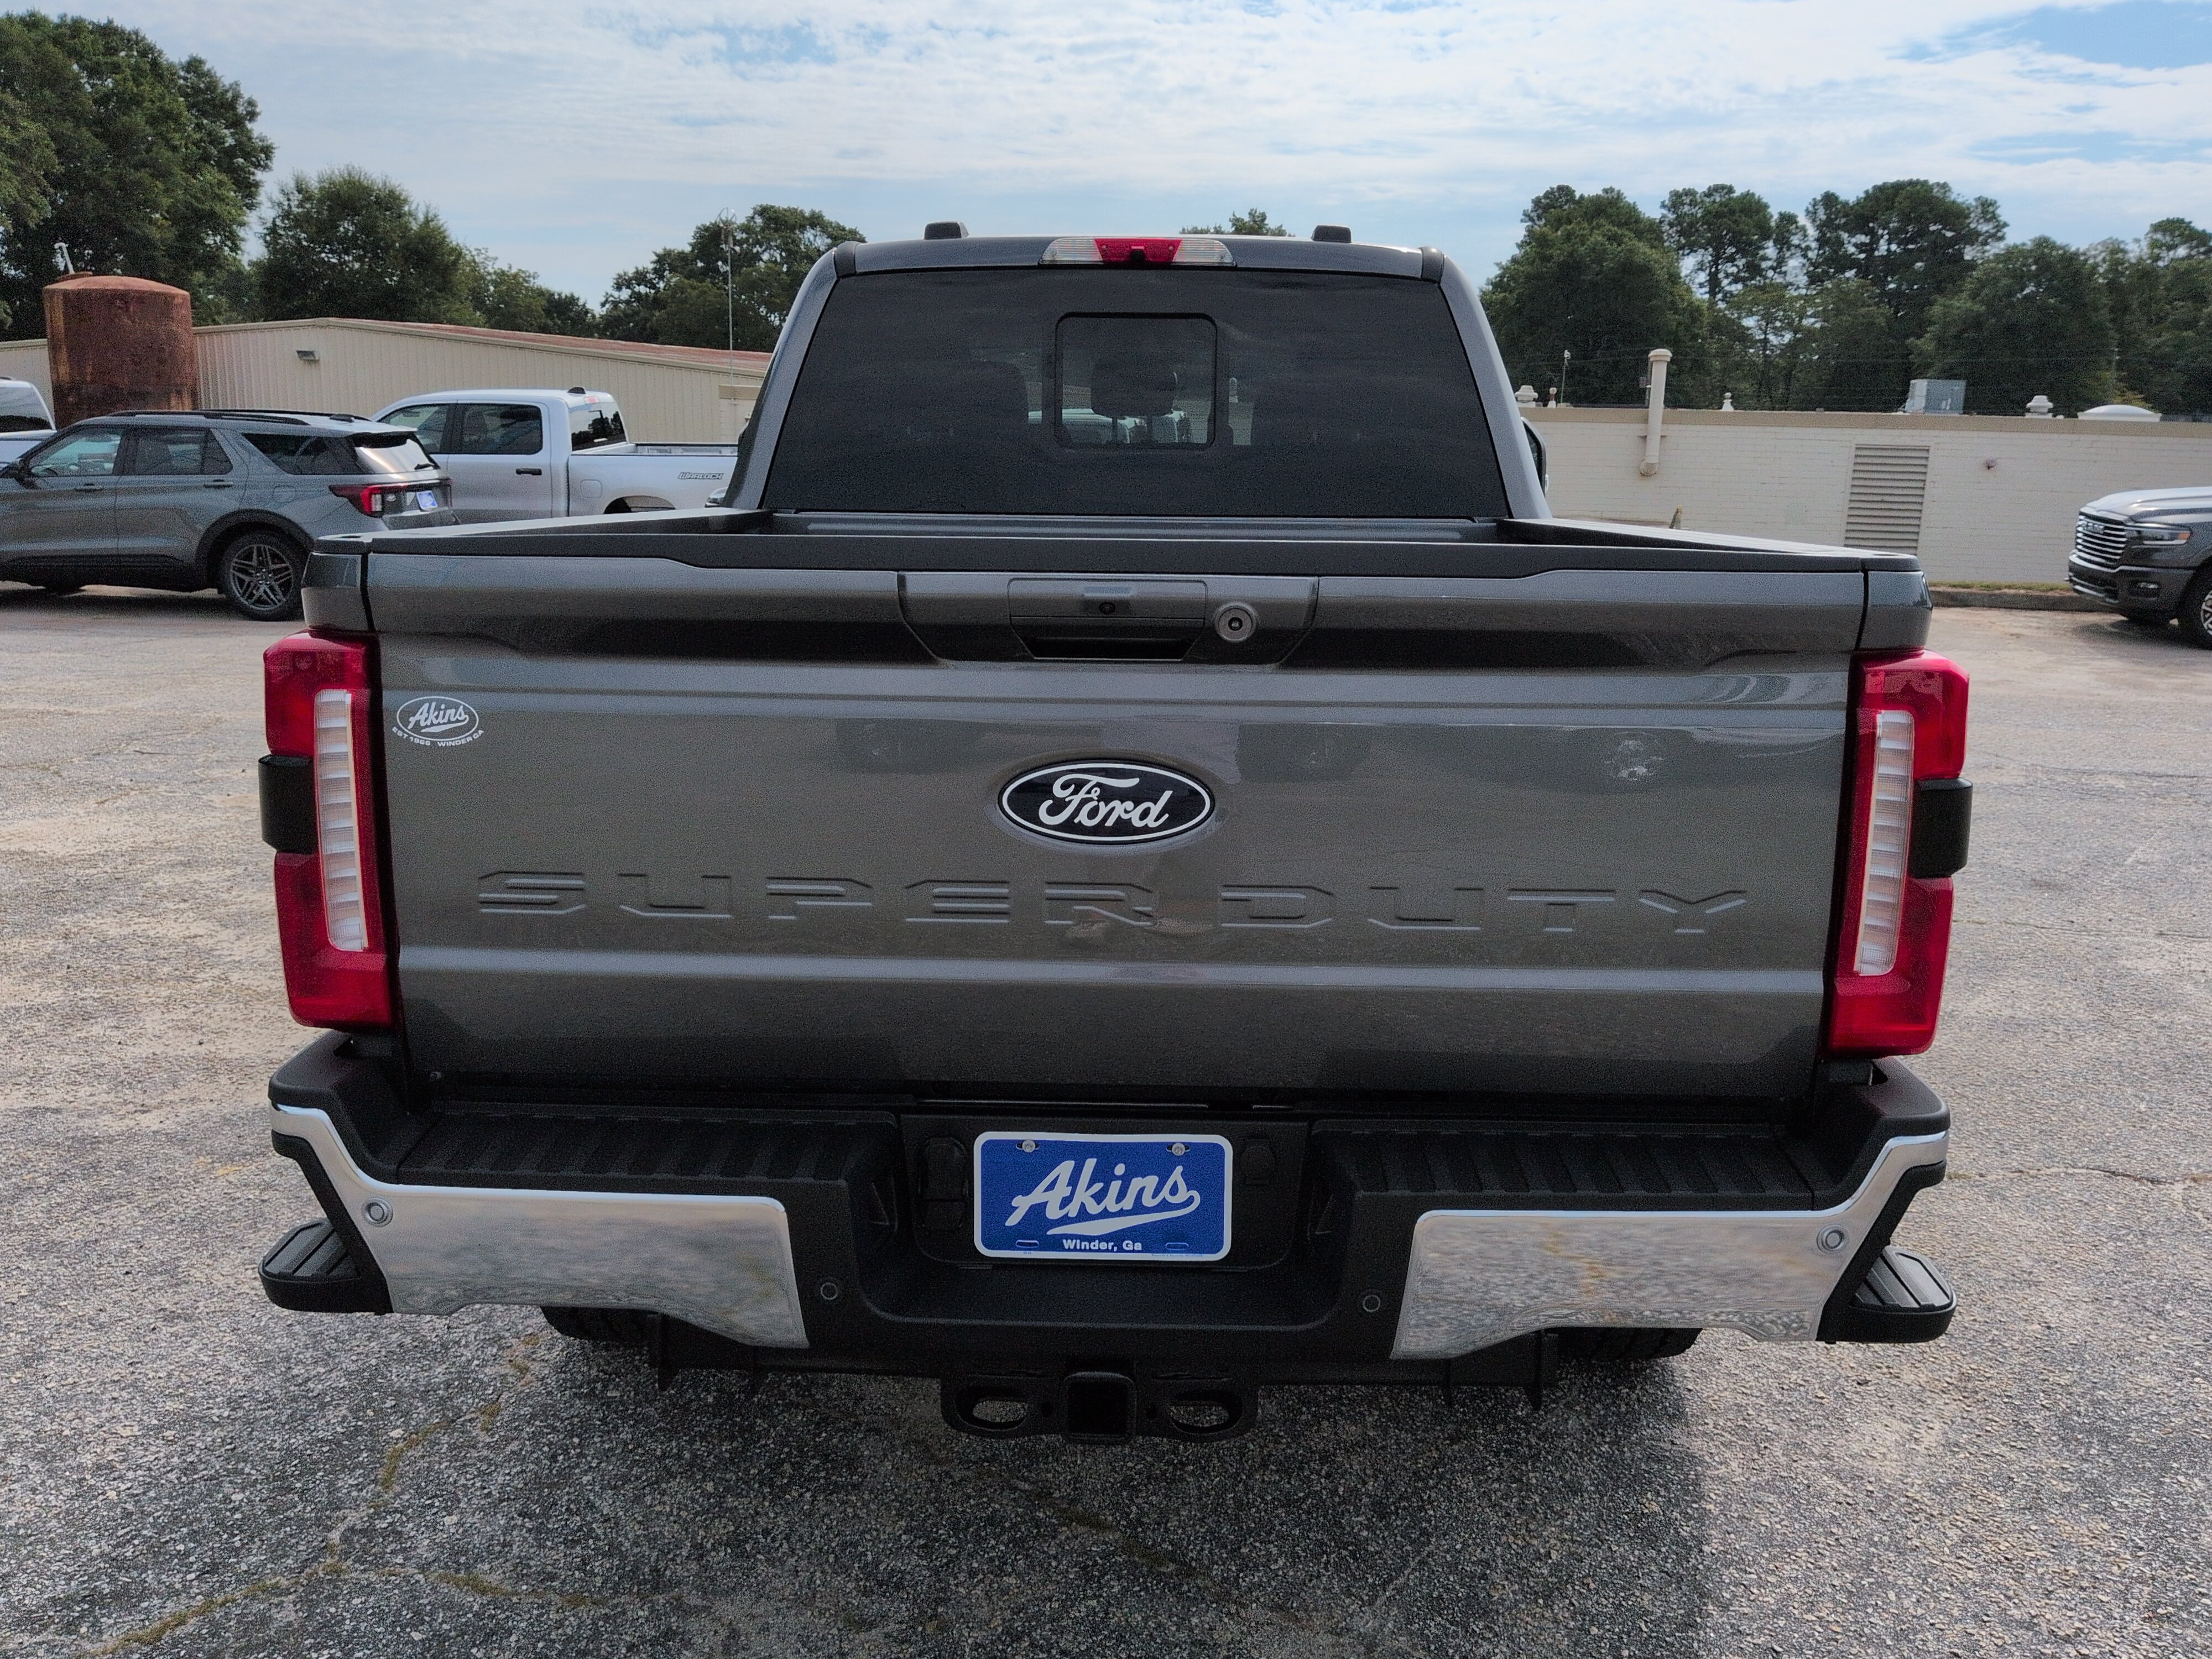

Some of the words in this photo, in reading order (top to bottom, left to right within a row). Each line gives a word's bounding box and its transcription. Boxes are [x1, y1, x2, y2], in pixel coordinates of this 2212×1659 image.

[678, 472, 725, 480] WARLOCK
[407, 701, 469, 733] Akins
[392, 726, 409, 739] EST
[437, 736, 473, 747] WINDER
[473, 729, 484, 739] GA
[1038, 773, 1173, 828] Ford
[478, 870, 1154, 926] SUPER
[1220, 884, 1748, 933] DUTY
[1004, 1158, 1201, 1236] Akins
[1062, 1239, 1118, 1251] Winder,
[1122, 1240, 1142, 1251] Ga
